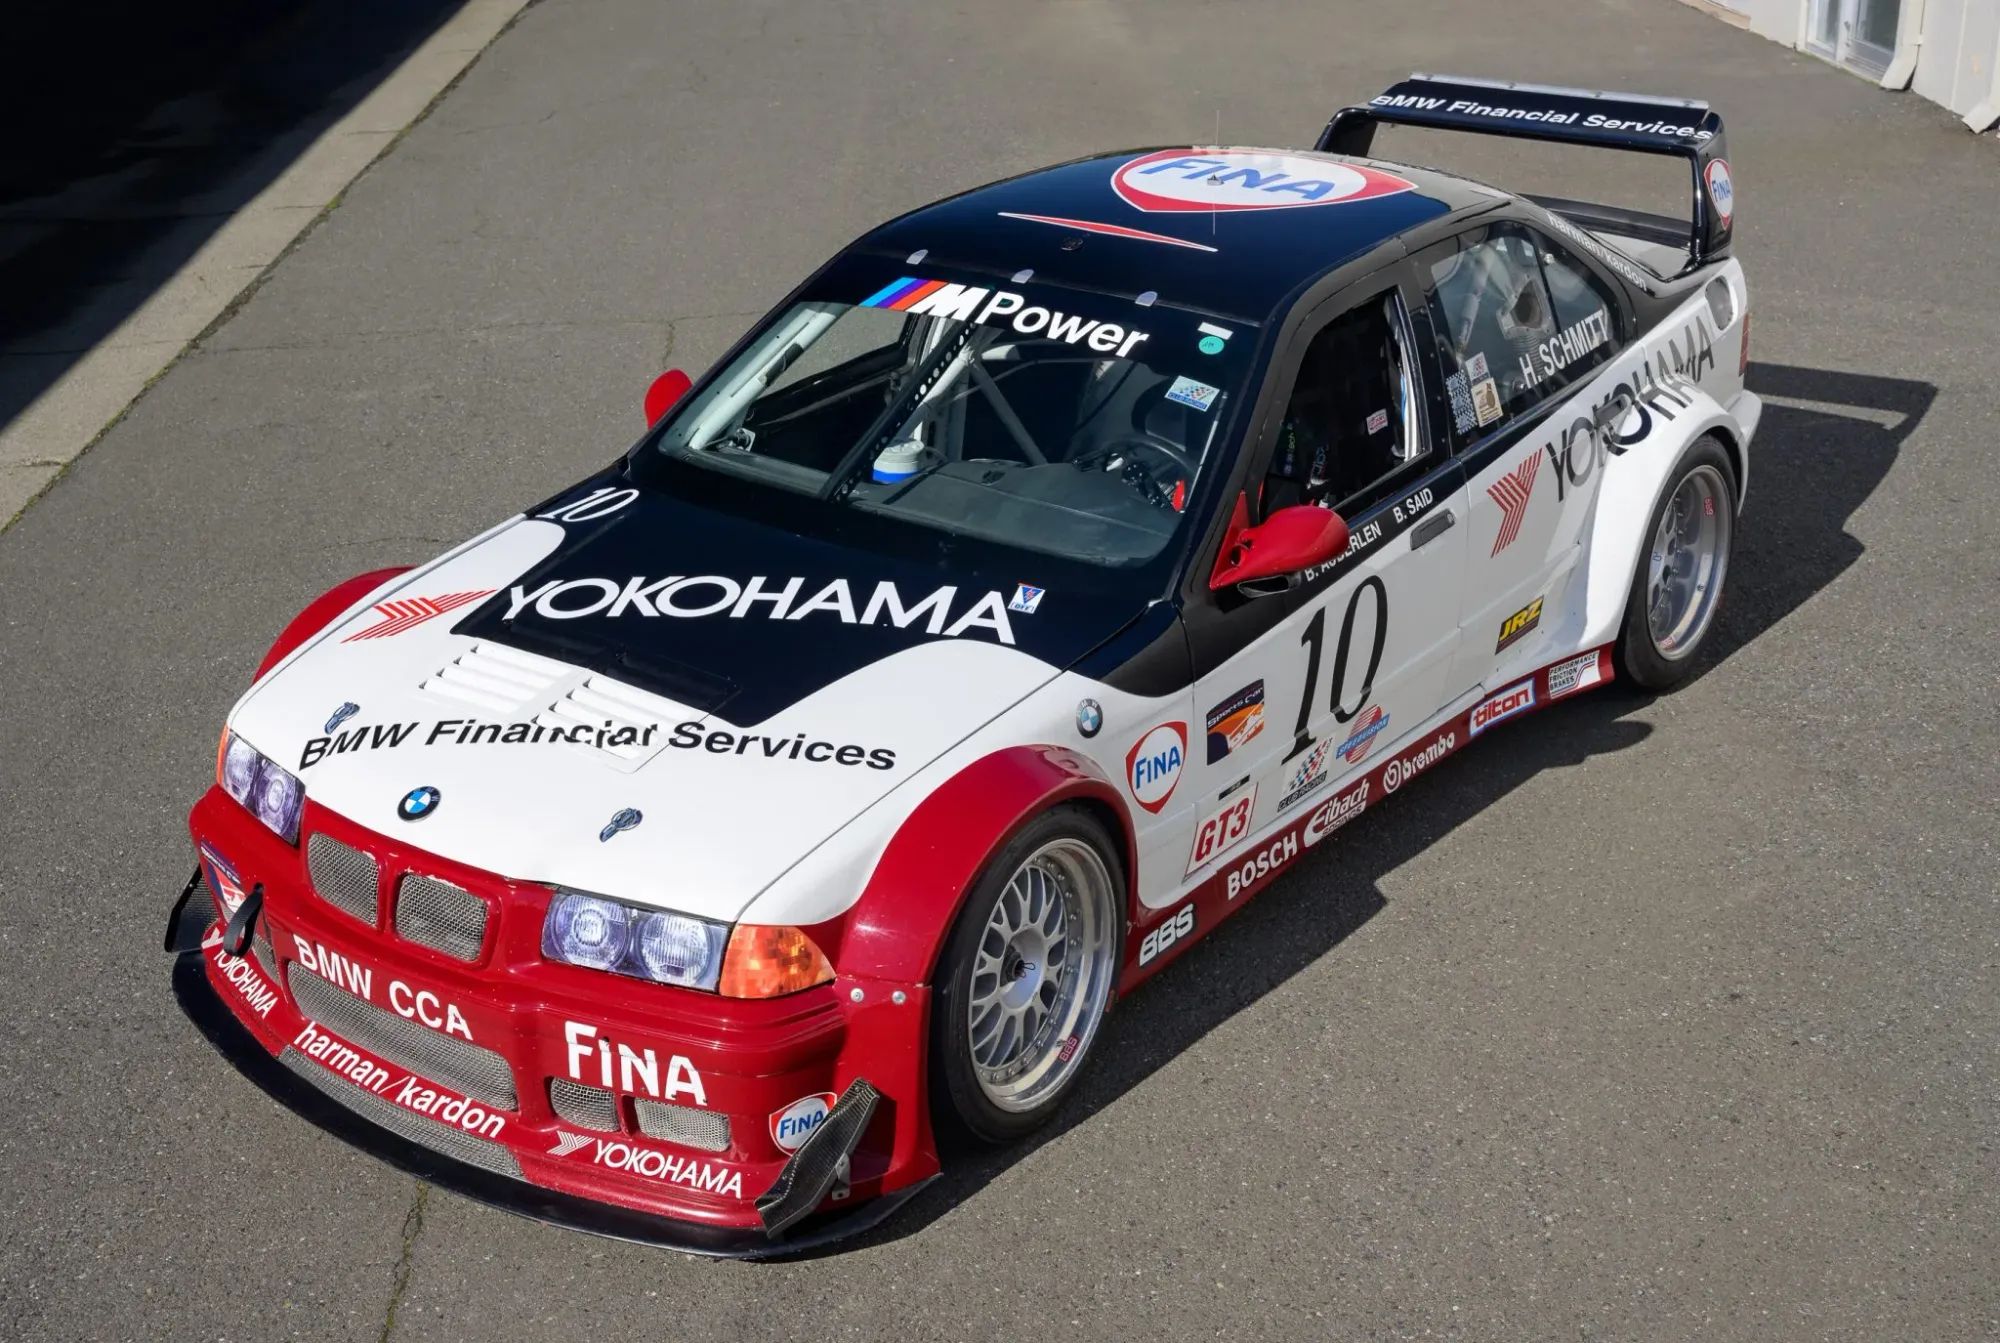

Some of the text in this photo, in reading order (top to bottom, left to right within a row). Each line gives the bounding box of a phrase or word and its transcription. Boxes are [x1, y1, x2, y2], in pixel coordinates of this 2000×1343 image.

[1371, 94, 1713, 139] BMW Financial Services
[1136, 157, 1337, 202] FINA
[1711, 180, 1732, 202] FINA
[1519, 310, 1609, 389] H. SCHMITT
[534, 486, 640, 522] 10
[1392, 506, 1407, 524] B.
[1405, 488, 1434, 515] SAID
[502, 575, 1016, 645] YOKOHAMA
[1281, 574, 1389, 766] 10
[1549, 652, 1597, 676] PERFORMANCE
[1549, 667, 1578, 683] FRICTION
[1549, 676, 1575, 691] BRAKES
[1473, 687, 1530, 728] tilton
[299, 719, 897, 771] BMW Financial Services
[1135, 745, 1182, 790] FINA
[1402, 731, 1455, 780] brembo
[1194, 797, 1250, 863] GT3
[1303, 777, 1370, 848] Eibach
[1227, 831, 1298, 901] BOSCH
[1139, 903, 1195, 968] BBS
[292, 934, 473, 1041] BMW CCA
[564, 1020, 708, 1107] FINA
[779, 1110, 825, 1140] FINA
[593, 1139, 743, 1200] YOKOHAMA
